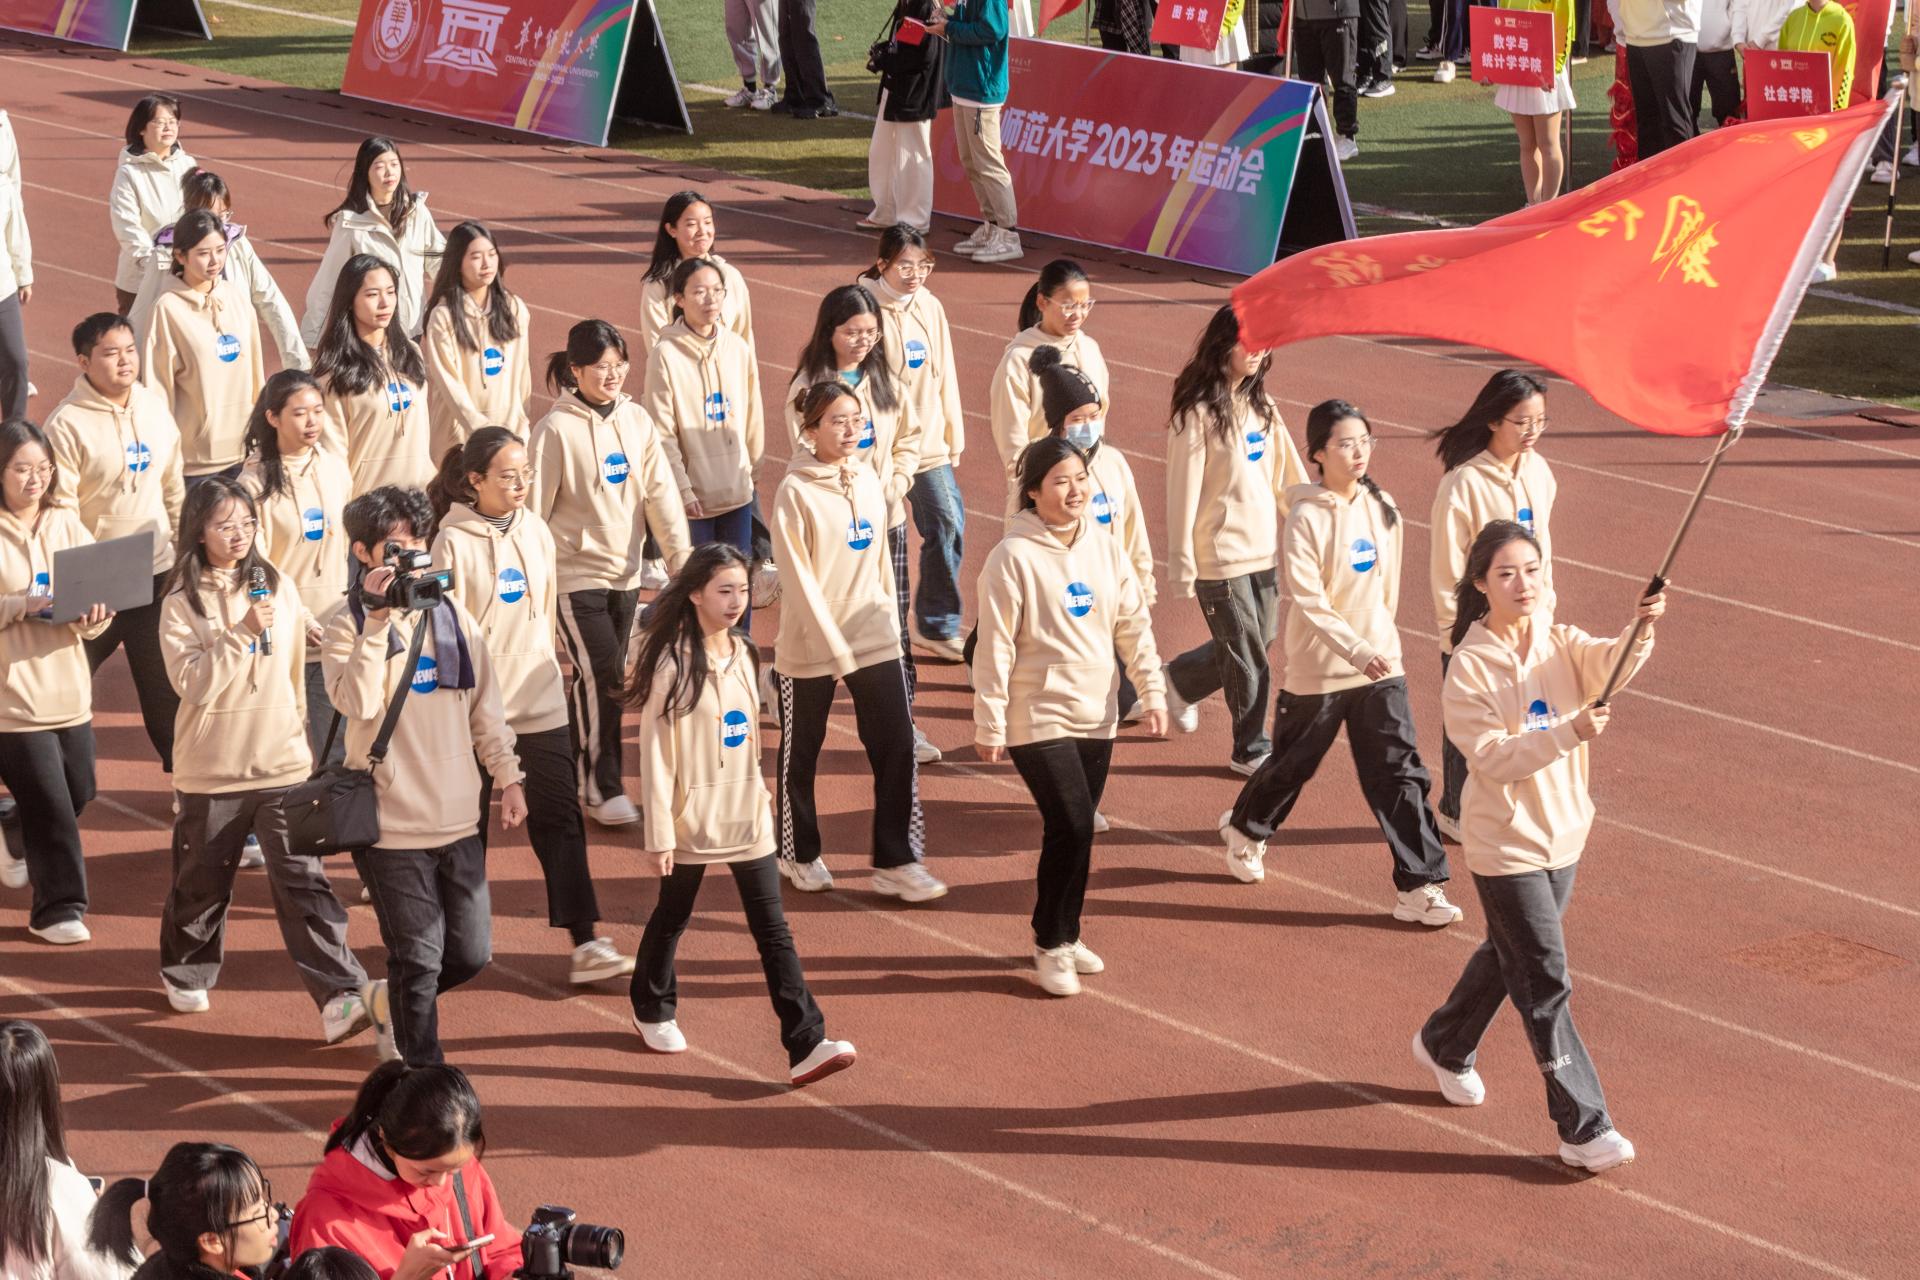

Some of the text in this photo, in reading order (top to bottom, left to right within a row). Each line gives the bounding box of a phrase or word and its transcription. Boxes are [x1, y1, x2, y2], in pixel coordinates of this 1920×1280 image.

[1493, 33, 1529, 52] 数学与
[1764, 85, 1813, 104] 社会学院
[499, 577, 528, 595] NEWS
[1065, 589, 1092, 608] NEWS
